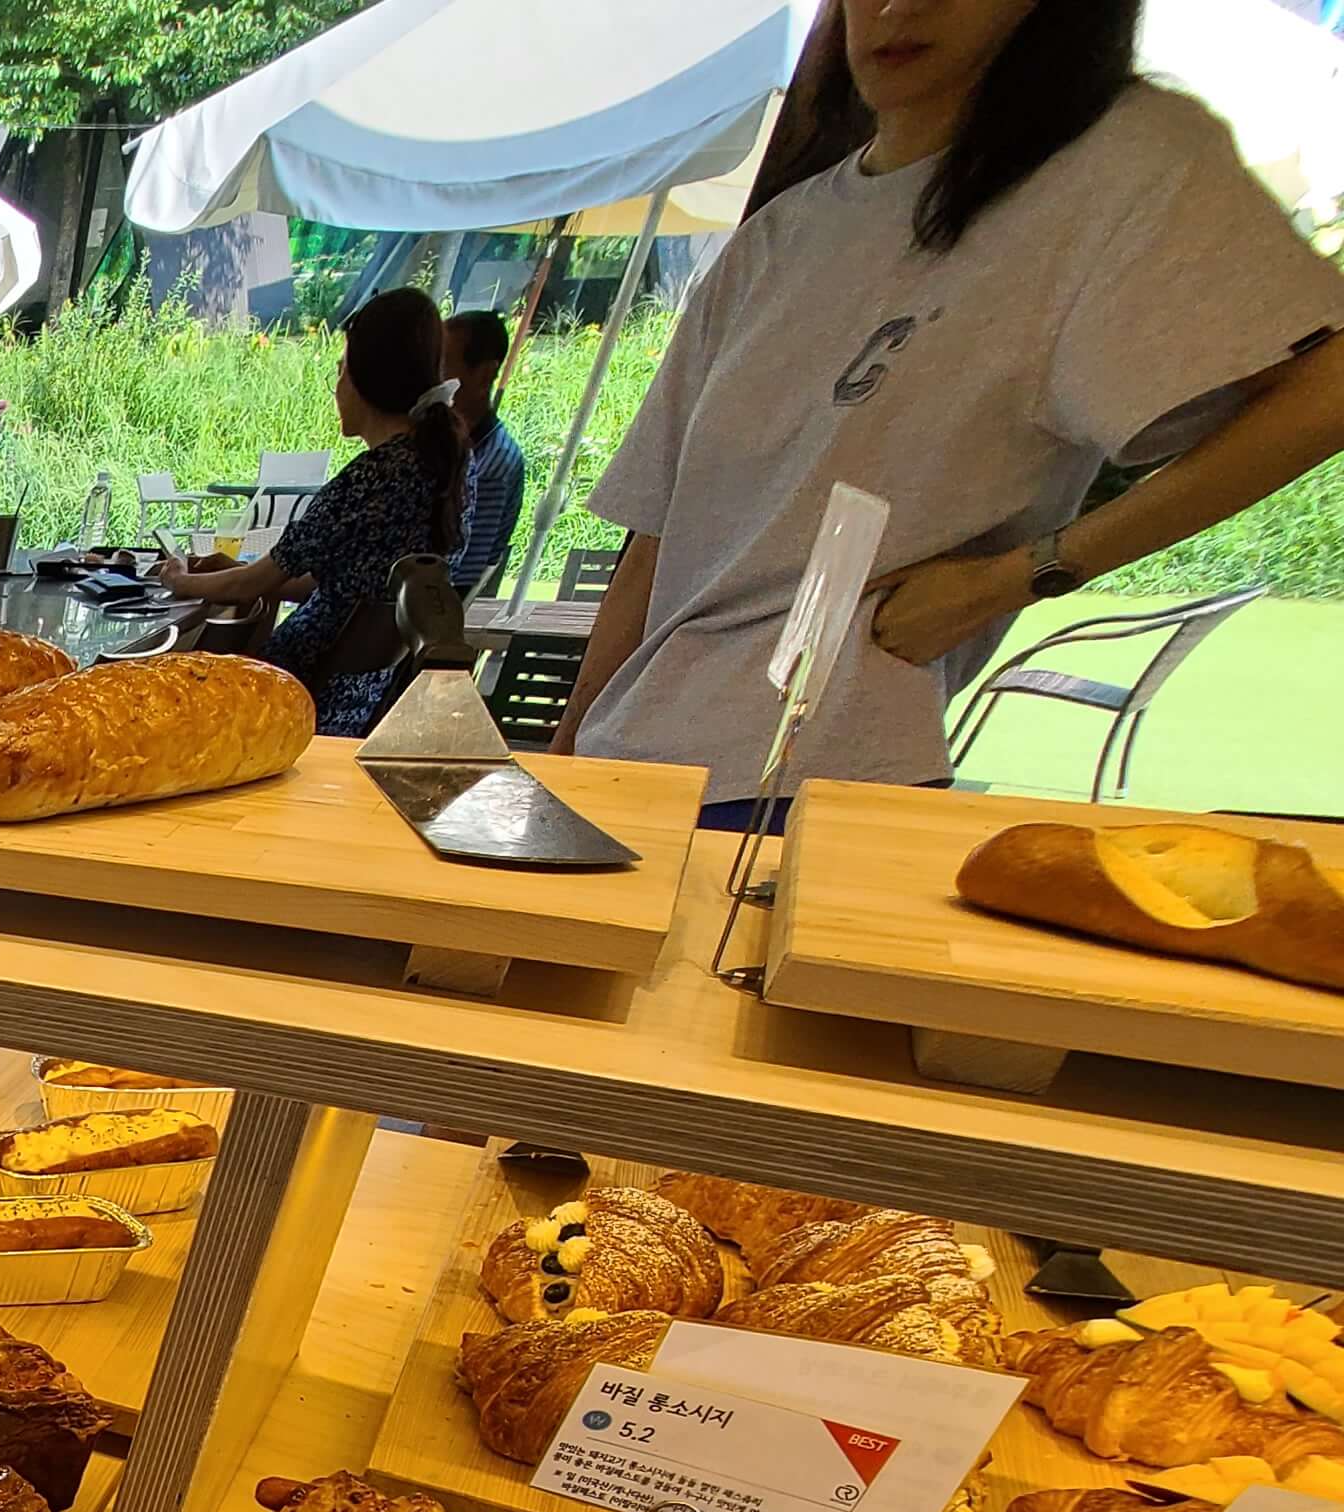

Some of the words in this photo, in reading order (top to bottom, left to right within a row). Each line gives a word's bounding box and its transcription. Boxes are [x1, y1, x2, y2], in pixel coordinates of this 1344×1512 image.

[600, 1381, 645, 1407] 바질
[647, 1393, 735, 1430] 롱소시지
[618, 1420, 656, 1444] 5.2
[847, 1433, 889, 1453] BEST
[558, 1442, 587, 1457] 맛있는
[588, 1451, 627, 1468] 돼지고기
[628, 1462, 676, 1481] 롱소시지에
[566, 1472, 577, 1482] 밀
[574, 1458, 594, 1470] 좋은
[684, 1491, 714, 1505] 누구나
